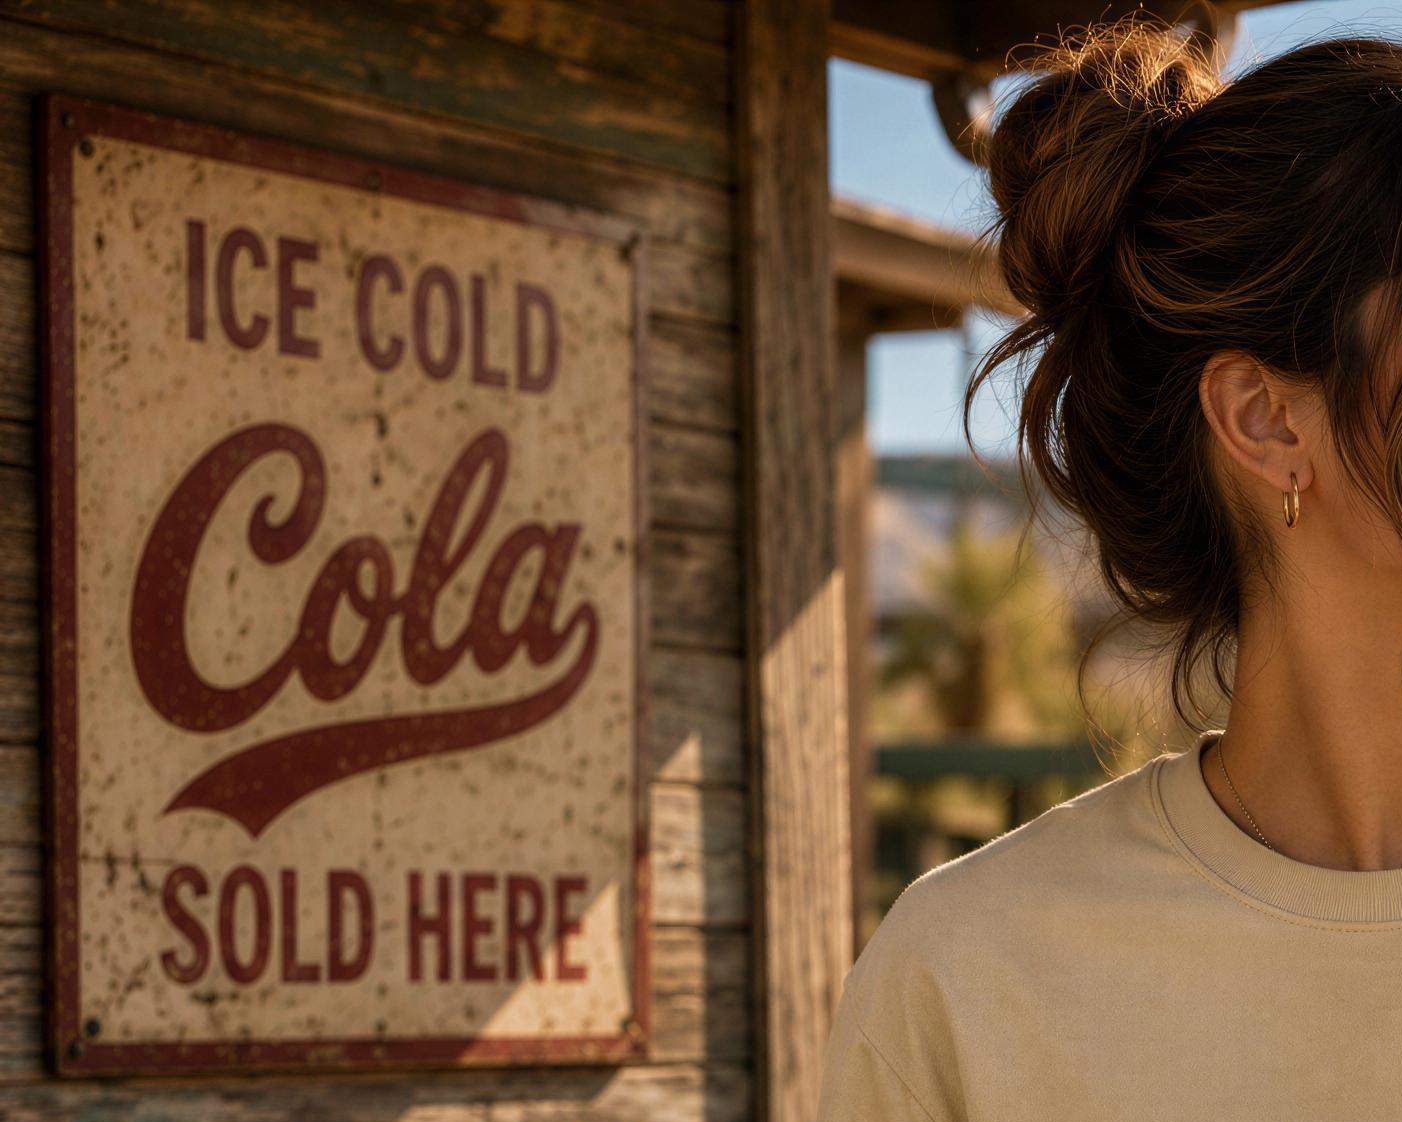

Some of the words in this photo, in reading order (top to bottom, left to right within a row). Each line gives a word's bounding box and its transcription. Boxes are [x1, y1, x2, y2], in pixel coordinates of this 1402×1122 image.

[186, 217, 320, 359] ICE
[354, 253, 561, 394] COLD
[129, 421, 598, 736] Cola
[160, 863, 375, 985] SOLD
[407, 869, 589, 985] HERE
